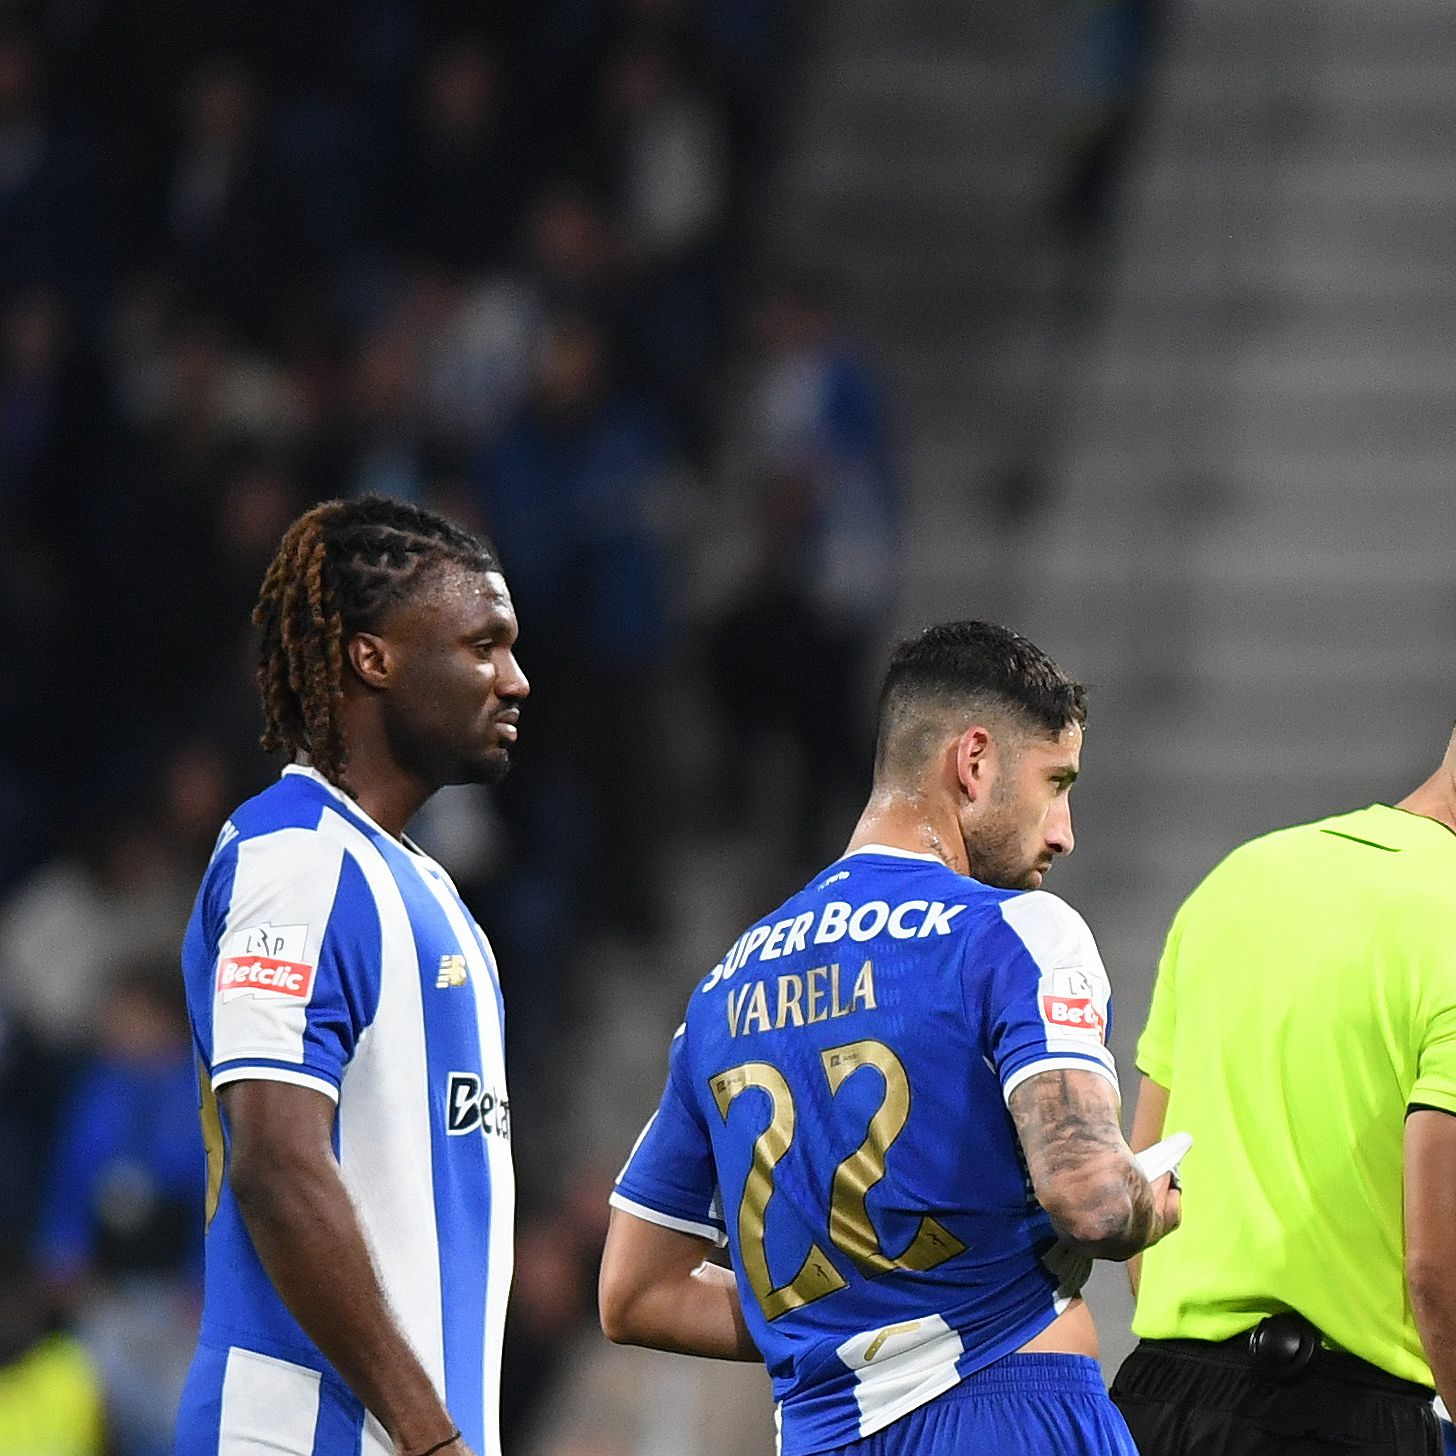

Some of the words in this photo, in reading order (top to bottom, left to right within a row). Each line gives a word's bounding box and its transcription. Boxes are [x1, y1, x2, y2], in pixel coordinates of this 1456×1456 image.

[221, 962, 304, 991] Betclic
[701, 911, 815, 993] SUPER
[813, 901, 967, 945] BOCK
[727, 960, 878, 1039] VARELA
[708, 1038, 969, 1323] 22
